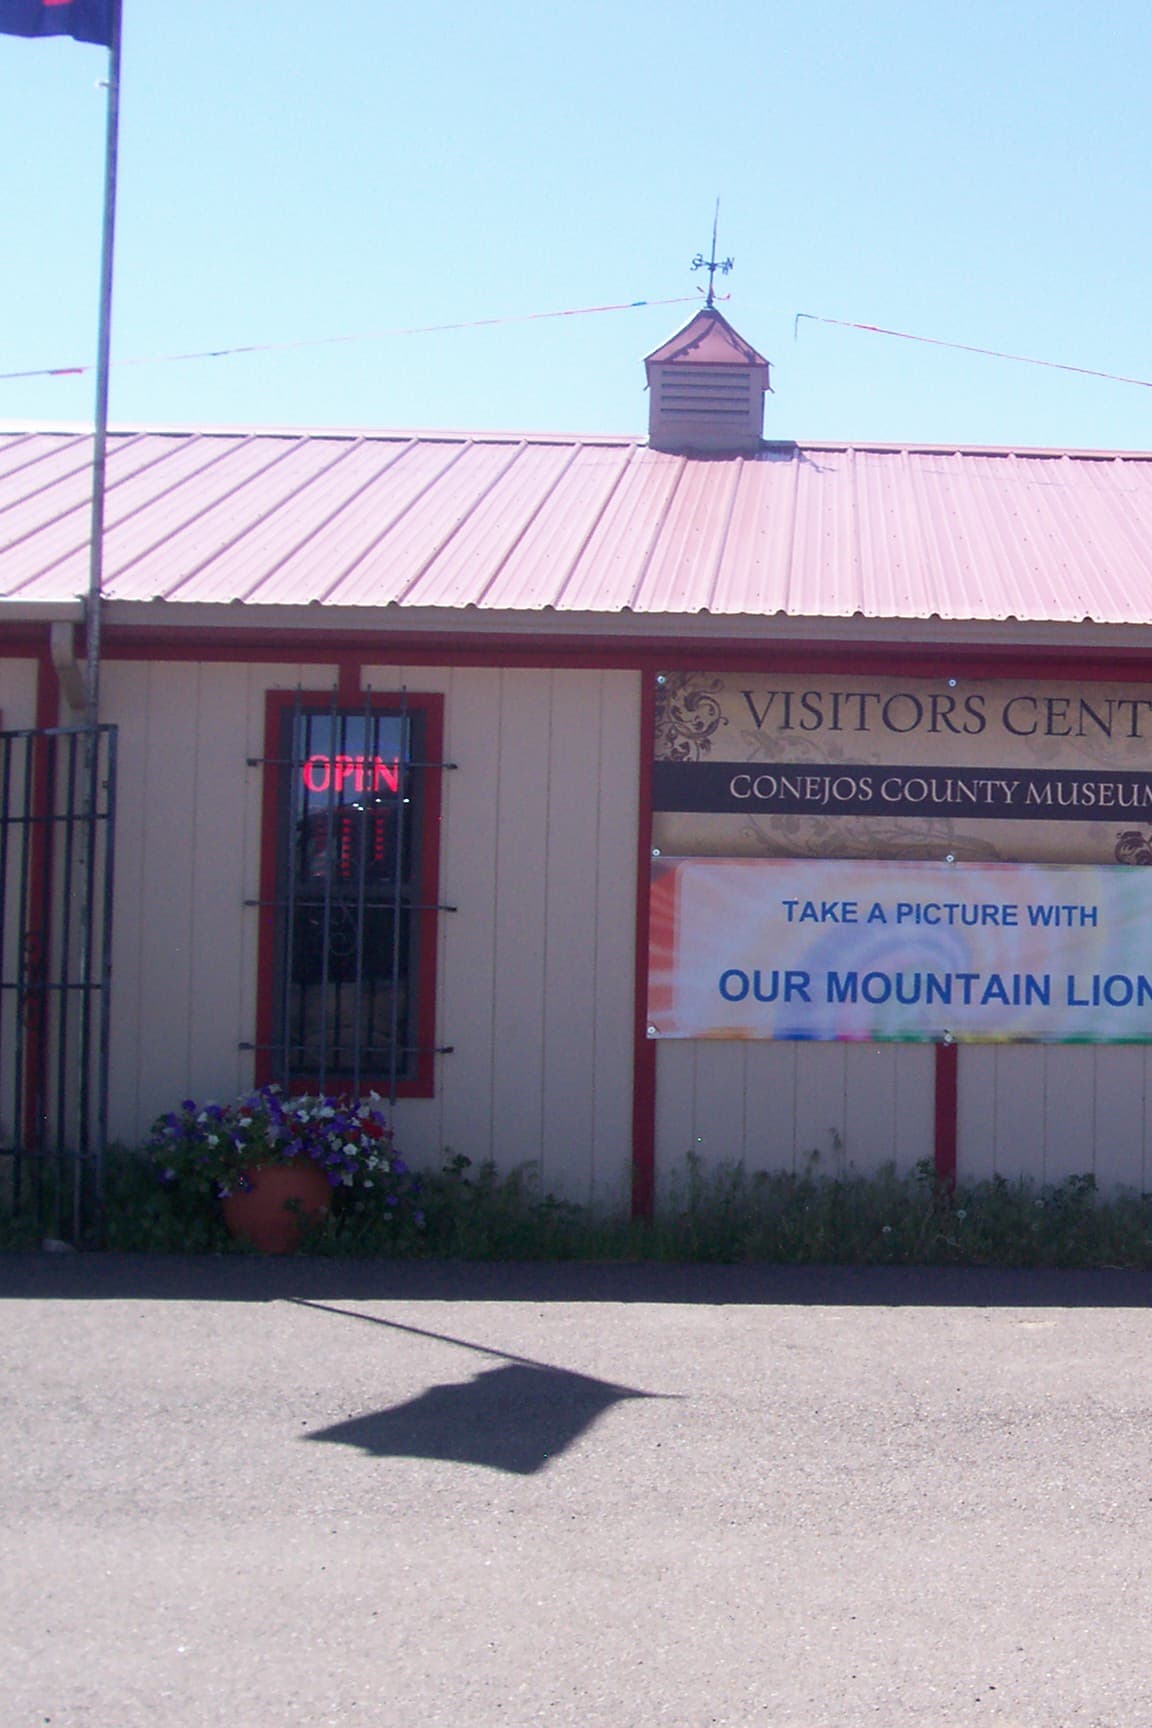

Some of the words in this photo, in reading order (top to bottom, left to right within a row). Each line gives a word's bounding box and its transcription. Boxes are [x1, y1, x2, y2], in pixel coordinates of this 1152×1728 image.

[740, 690, 988, 735] VISITORS
[303, 755, 399, 793] OPEN
[729, 774, 873, 805] CONEJOS
[880, 778, 1021, 807] COUNTY
[783, 901, 858, 923] TAKE
[867, 903, 888, 924] A
[897, 903, 1018, 926] PICTURE
[1027, 905, 1098, 927] WITH
[719, 969, 811, 1004] OUR
[827, 971, 1051, 1006] MOUNTAIN
